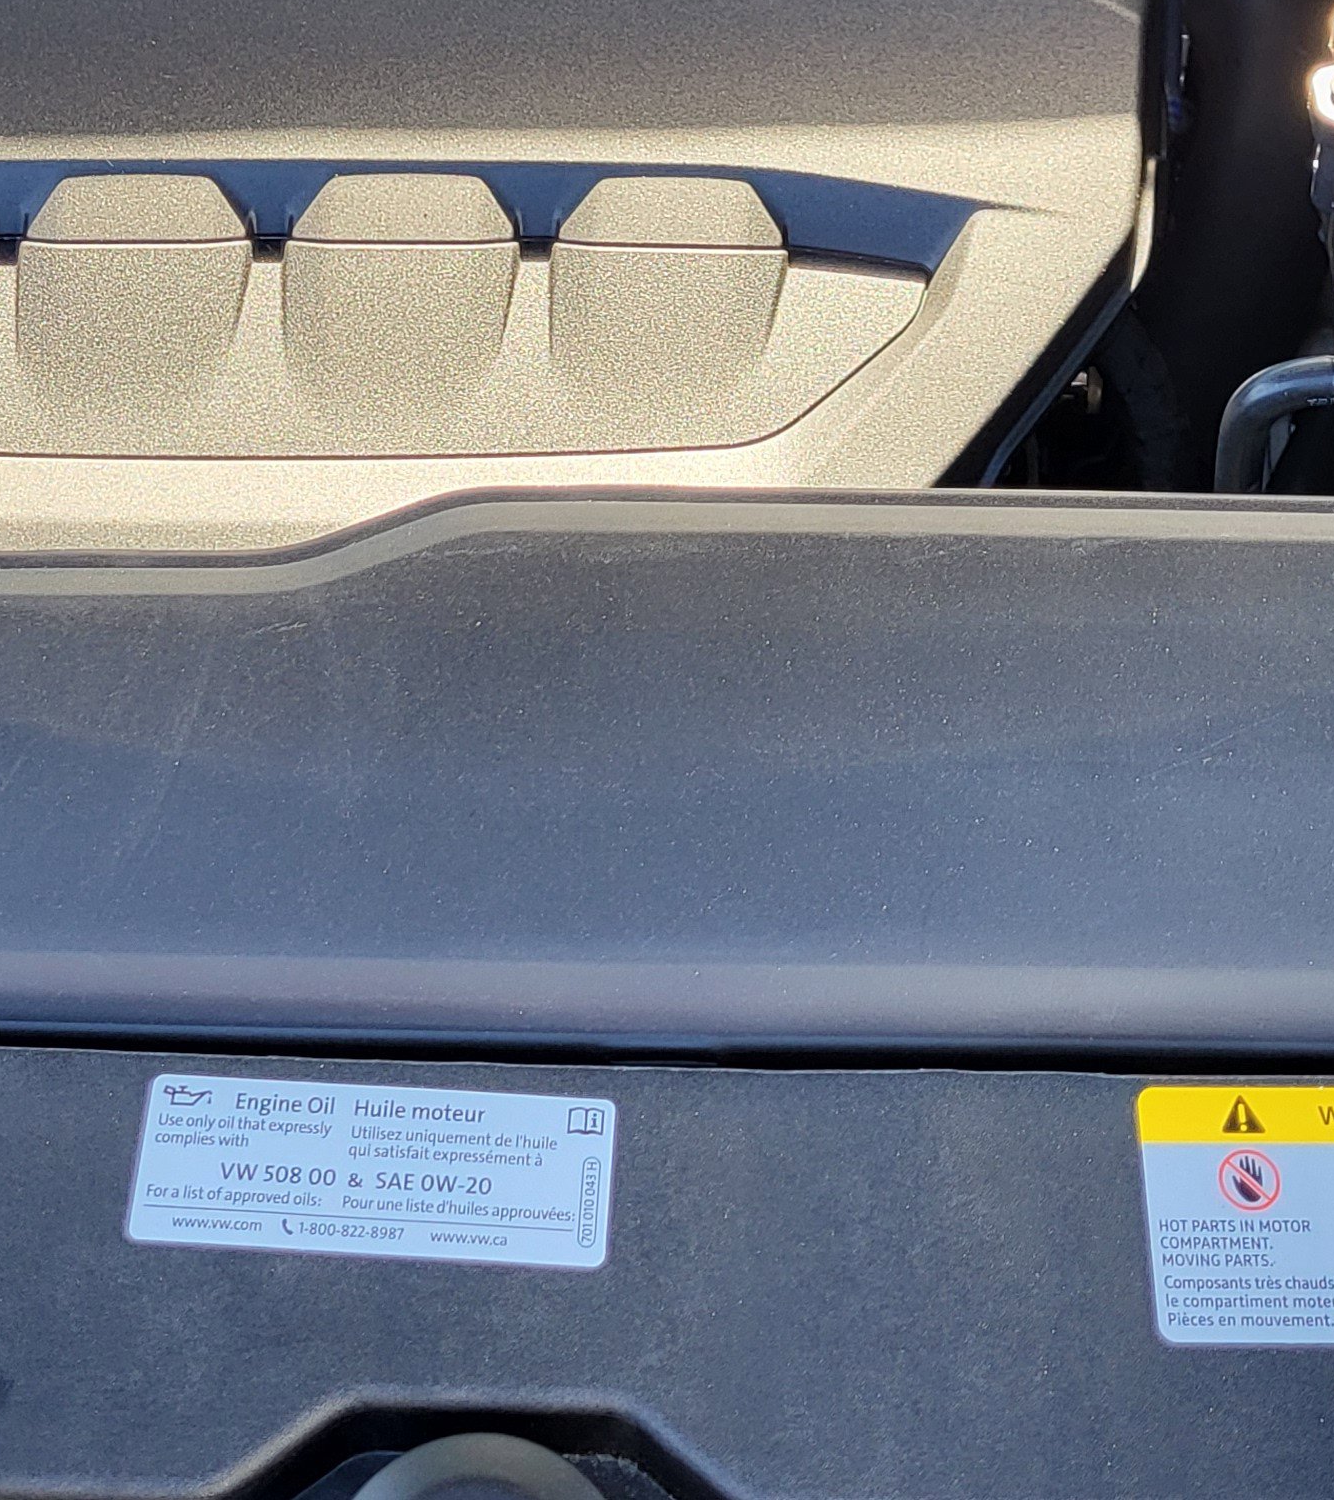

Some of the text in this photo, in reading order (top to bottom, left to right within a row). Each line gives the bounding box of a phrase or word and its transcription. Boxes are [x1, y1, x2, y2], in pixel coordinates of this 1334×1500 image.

[235, 1092, 336, 1115] Engine Oil
[354, 1099, 486, 1124] Huile moteur
[158, 1112, 333, 1139] Use only oil that expressly
[154, 1131, 250, 1148] complies with
[351, 1125, 403, 1141] Utilisez
[405, 1128, 491, 1147] uniquement
[348, 1142, 532, 1167] qui satisfait expressément
[220, 1161, 492, 1196] VW 508 00 & SAE 0W-20
[145, 1183, 323, 1207] For list of approved oils:
[341, 1195, 375, 1210] Pour
[376, 1199, 403, 1212] une
[405, 1197, 435, 1214] liste
[491, 1206, 576, 1222] approuvées:
[579, 1174, 597, 1245] 701 010 043
[171, 1216, 263, 1232] www.vw.com
[299, 1221, 405, 1241] 1-800-822-8987
[1159, 1219, 1312, 1233] HOT PARTS MOTOR
[430, 1232, 508, 1247] www.vw.ca
[1160, 1236, 1274, 1250] COMPARTMENT.
[1162, 1253, 1273, 1268] MOVING PARTS.
[1163, 1275, 1252, 1293] Composants
[1182, 1293, 1289, 1312] compartiment
[1167, 1311, 1334, 1328] Pièces mouvement.
